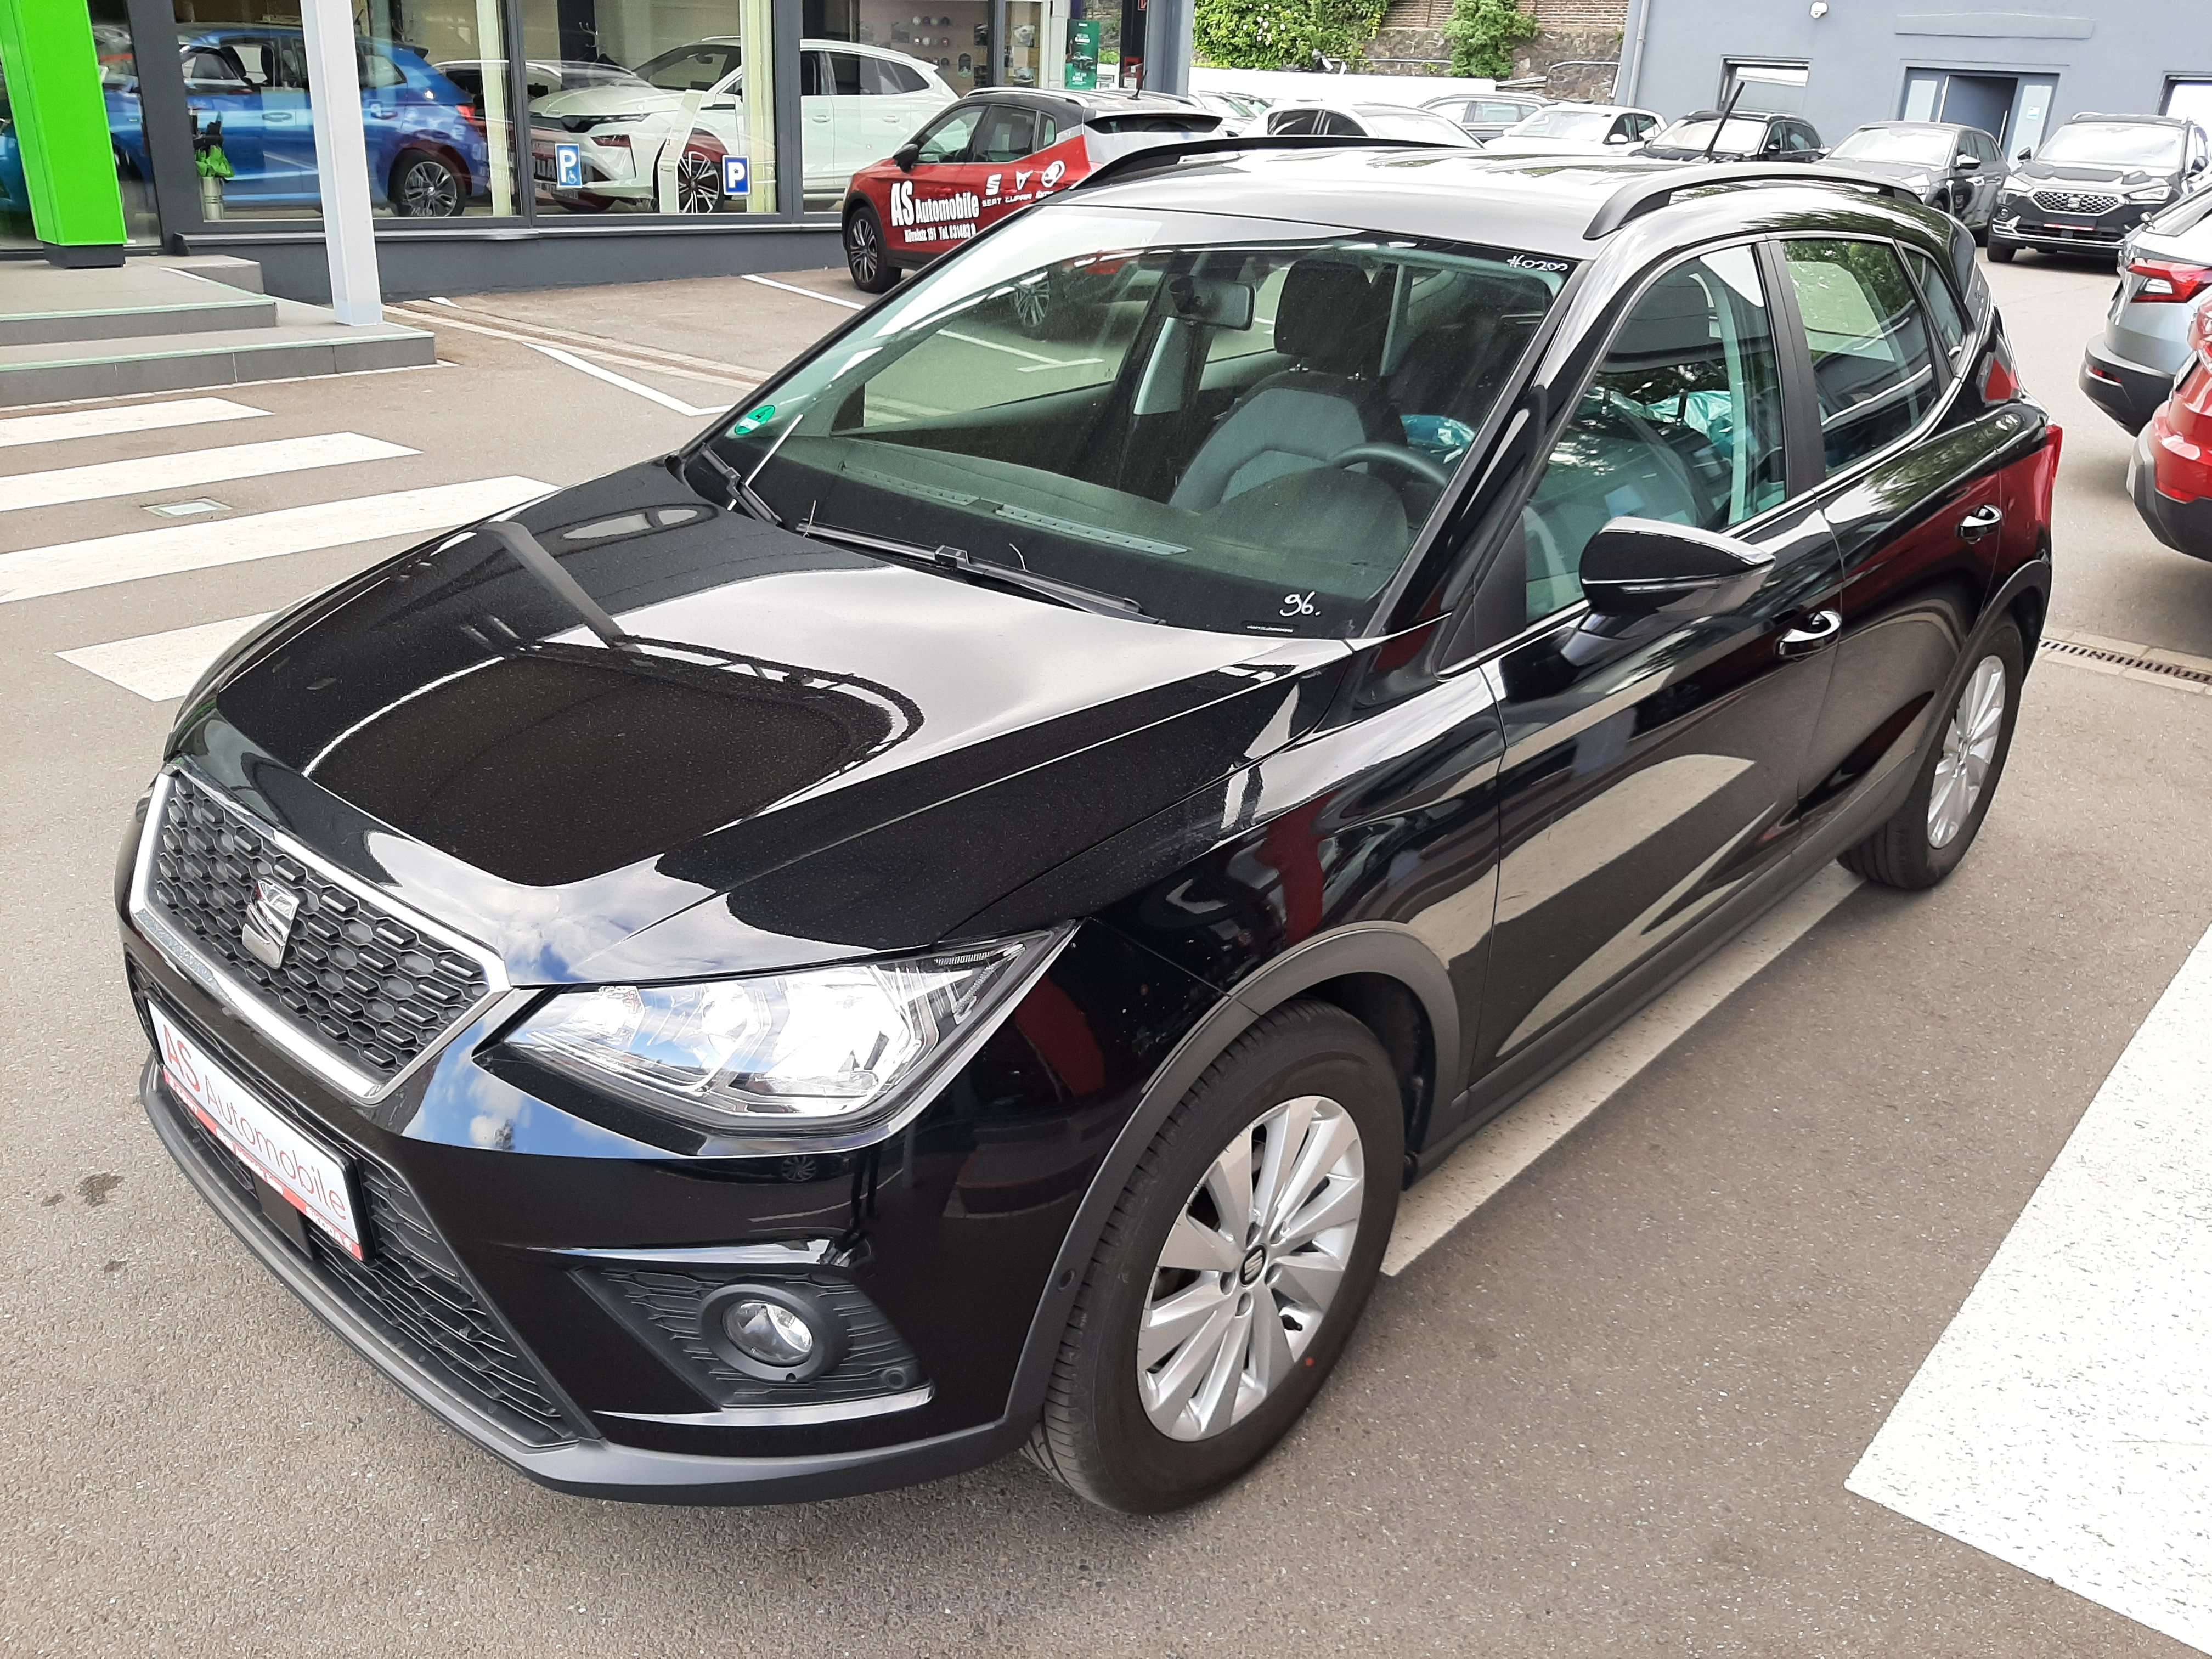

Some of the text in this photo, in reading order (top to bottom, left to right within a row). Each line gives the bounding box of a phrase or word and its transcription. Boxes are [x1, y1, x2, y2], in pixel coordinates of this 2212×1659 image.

[560, 150, 577, 183] P
[728, 162, 745, 188] P
[891, 180, 979, 227] AS Automobile
[163, 1024, 201, 1092] AS
[205, 1074, 347, 1221] Automobile
